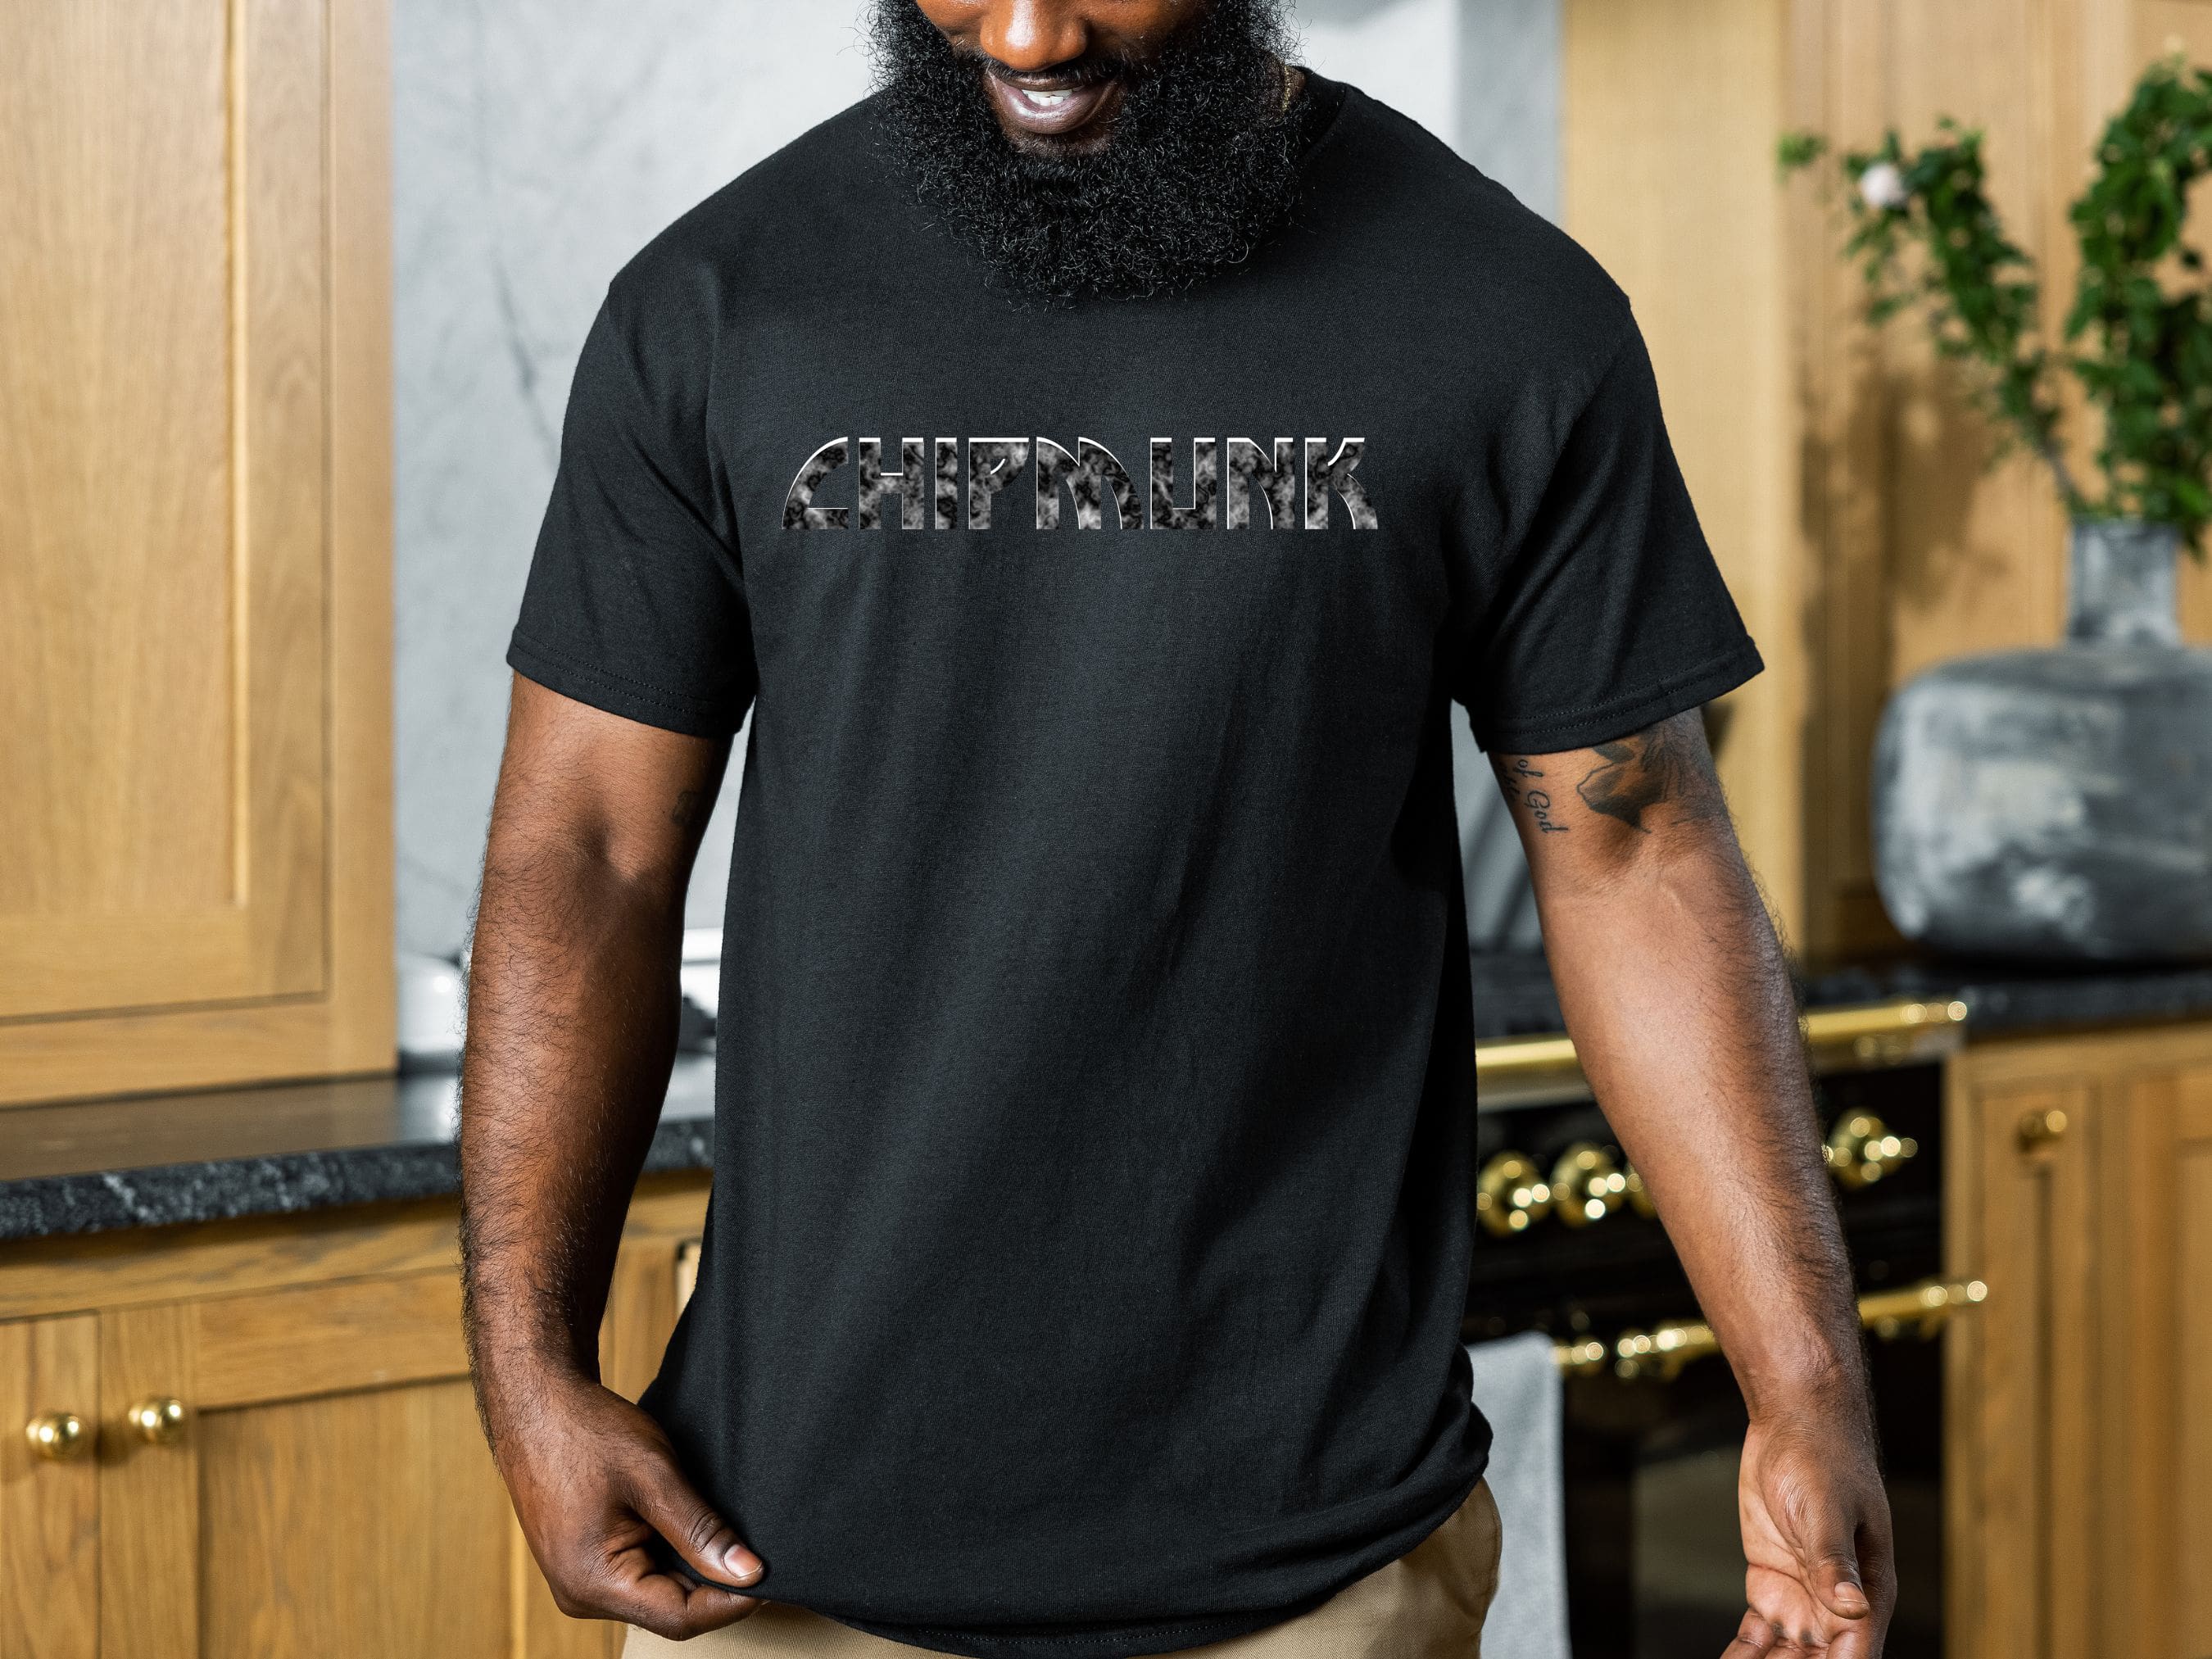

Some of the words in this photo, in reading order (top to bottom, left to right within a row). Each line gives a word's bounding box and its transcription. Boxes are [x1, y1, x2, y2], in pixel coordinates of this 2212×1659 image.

[782, 437, 1378, 530] CHIPMUNK
[1512, 759, 1544, 778] of
[1525, 790, 1569, 834] God
